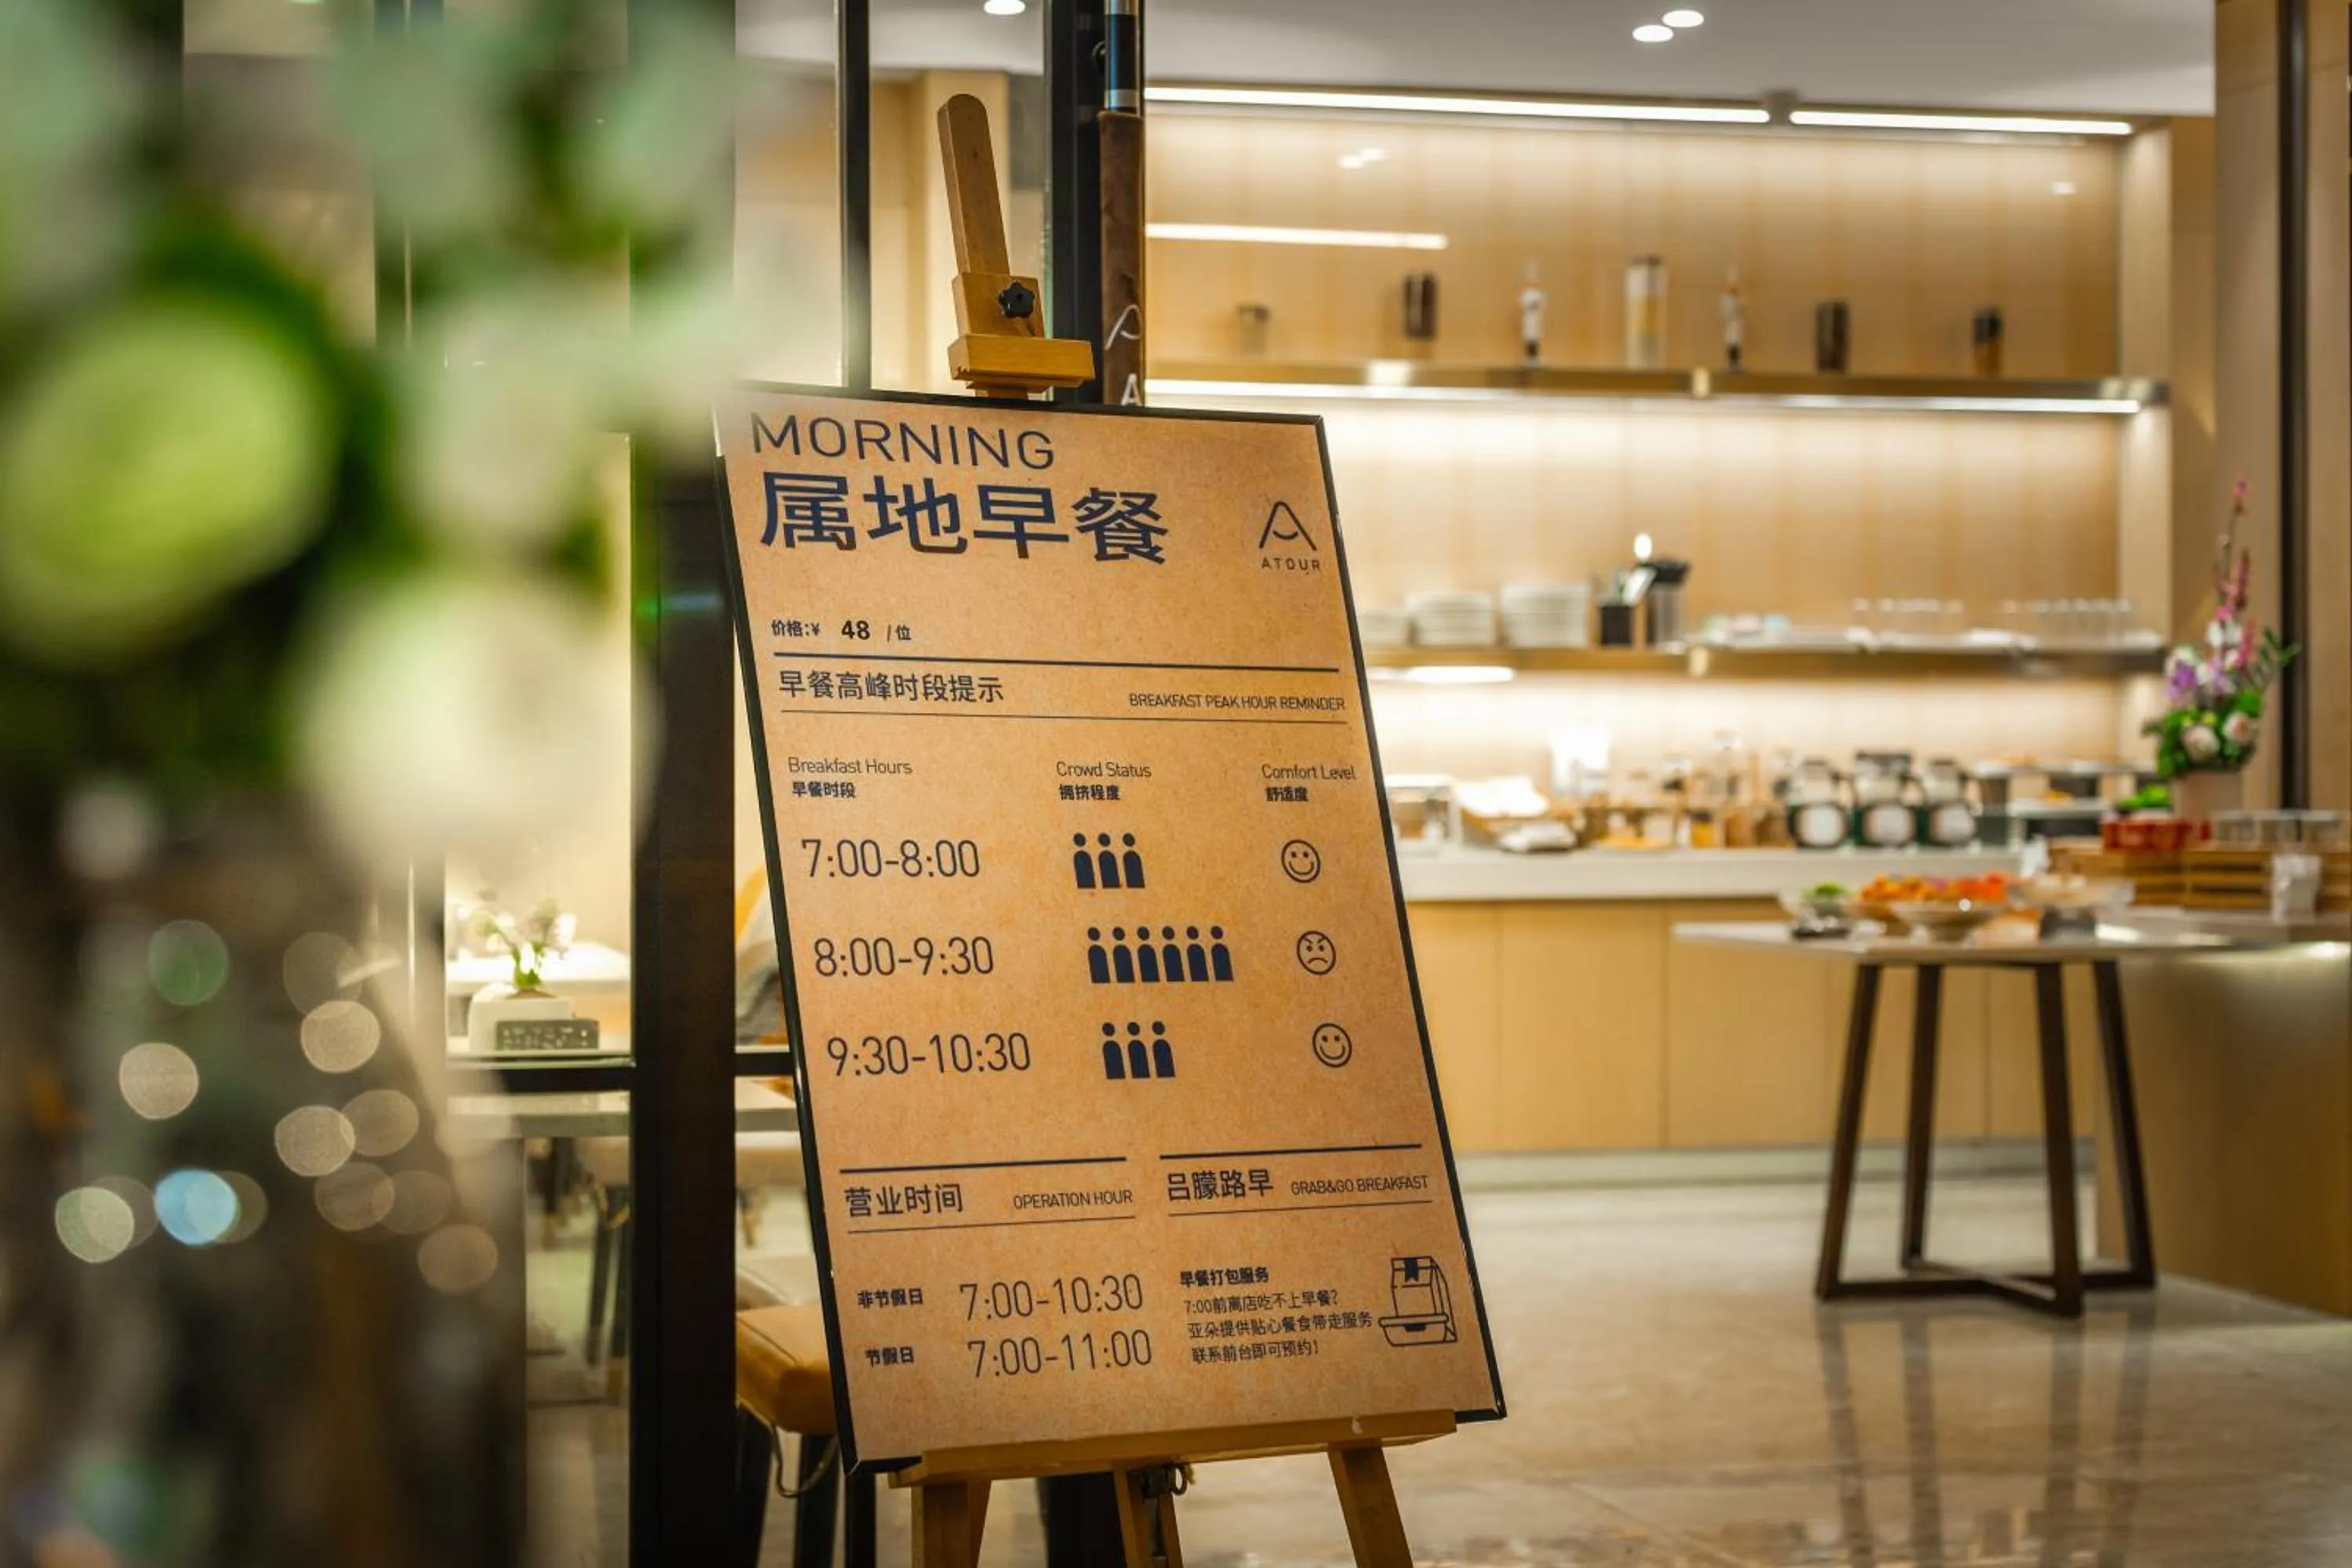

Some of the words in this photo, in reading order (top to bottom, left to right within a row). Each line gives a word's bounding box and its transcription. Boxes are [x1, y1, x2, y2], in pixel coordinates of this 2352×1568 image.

[753, 412, 1055, 470] MORNING
[760, 470, 1170, 565] 属地早餐
[1261, 557, 1320, 571] ATOUR
[841, 619, 871, 641] 48
[779, 670, 1004, 703] 早餐高峰时段提示
[1128, 692, 1202, 708] BREAKFAST
[1204, 694, 1240, 709] PEAK
[1241, 695, 1277, 710] HOUR
[1279, 695, 1345, 711] REMINDER
[787, 756, 862, 774] Breakfast
[865, 758, 913, 775] Hours
[1055, 760, 1103, 778] Crowd
[1105, 761, 1152, 779] Status
[1261, 764, 1318, 780] Comfort
[1319, 764, 1356, 781] Level
[792, 781, 856, 799] 早餐时段
[1058, 783, 1121, 801] 拥挤程度
[1265, 786, 1308, 802] 舒适度
[801, 839, 980, 878] 7:00-8:00
[814, 936, 994, 977] 8:00-9:30
[826, 1032, 1031, 1076] 9:30-10:30
[1290, 1178, 1355, 1196] GRAB&GO
[1356, 1174, 1428, 1192] BREAKFAST
[844, 1183, 964, 1218] 营业时间
[1013, 1191, 1091, 1210] OPERATION
[1093, 1189, 1133, 1205] HOUR
[1180, 1266, 1269, 1289] 早餐打包服务
[857, 1287, 924, 1309] 非节假日
[959, 1273, 1143, 1322] 7:00-10:30
[865, 1346, 914, 1367] 节假日
[967, 1329, 1152, 1379] 7:00-11:00
